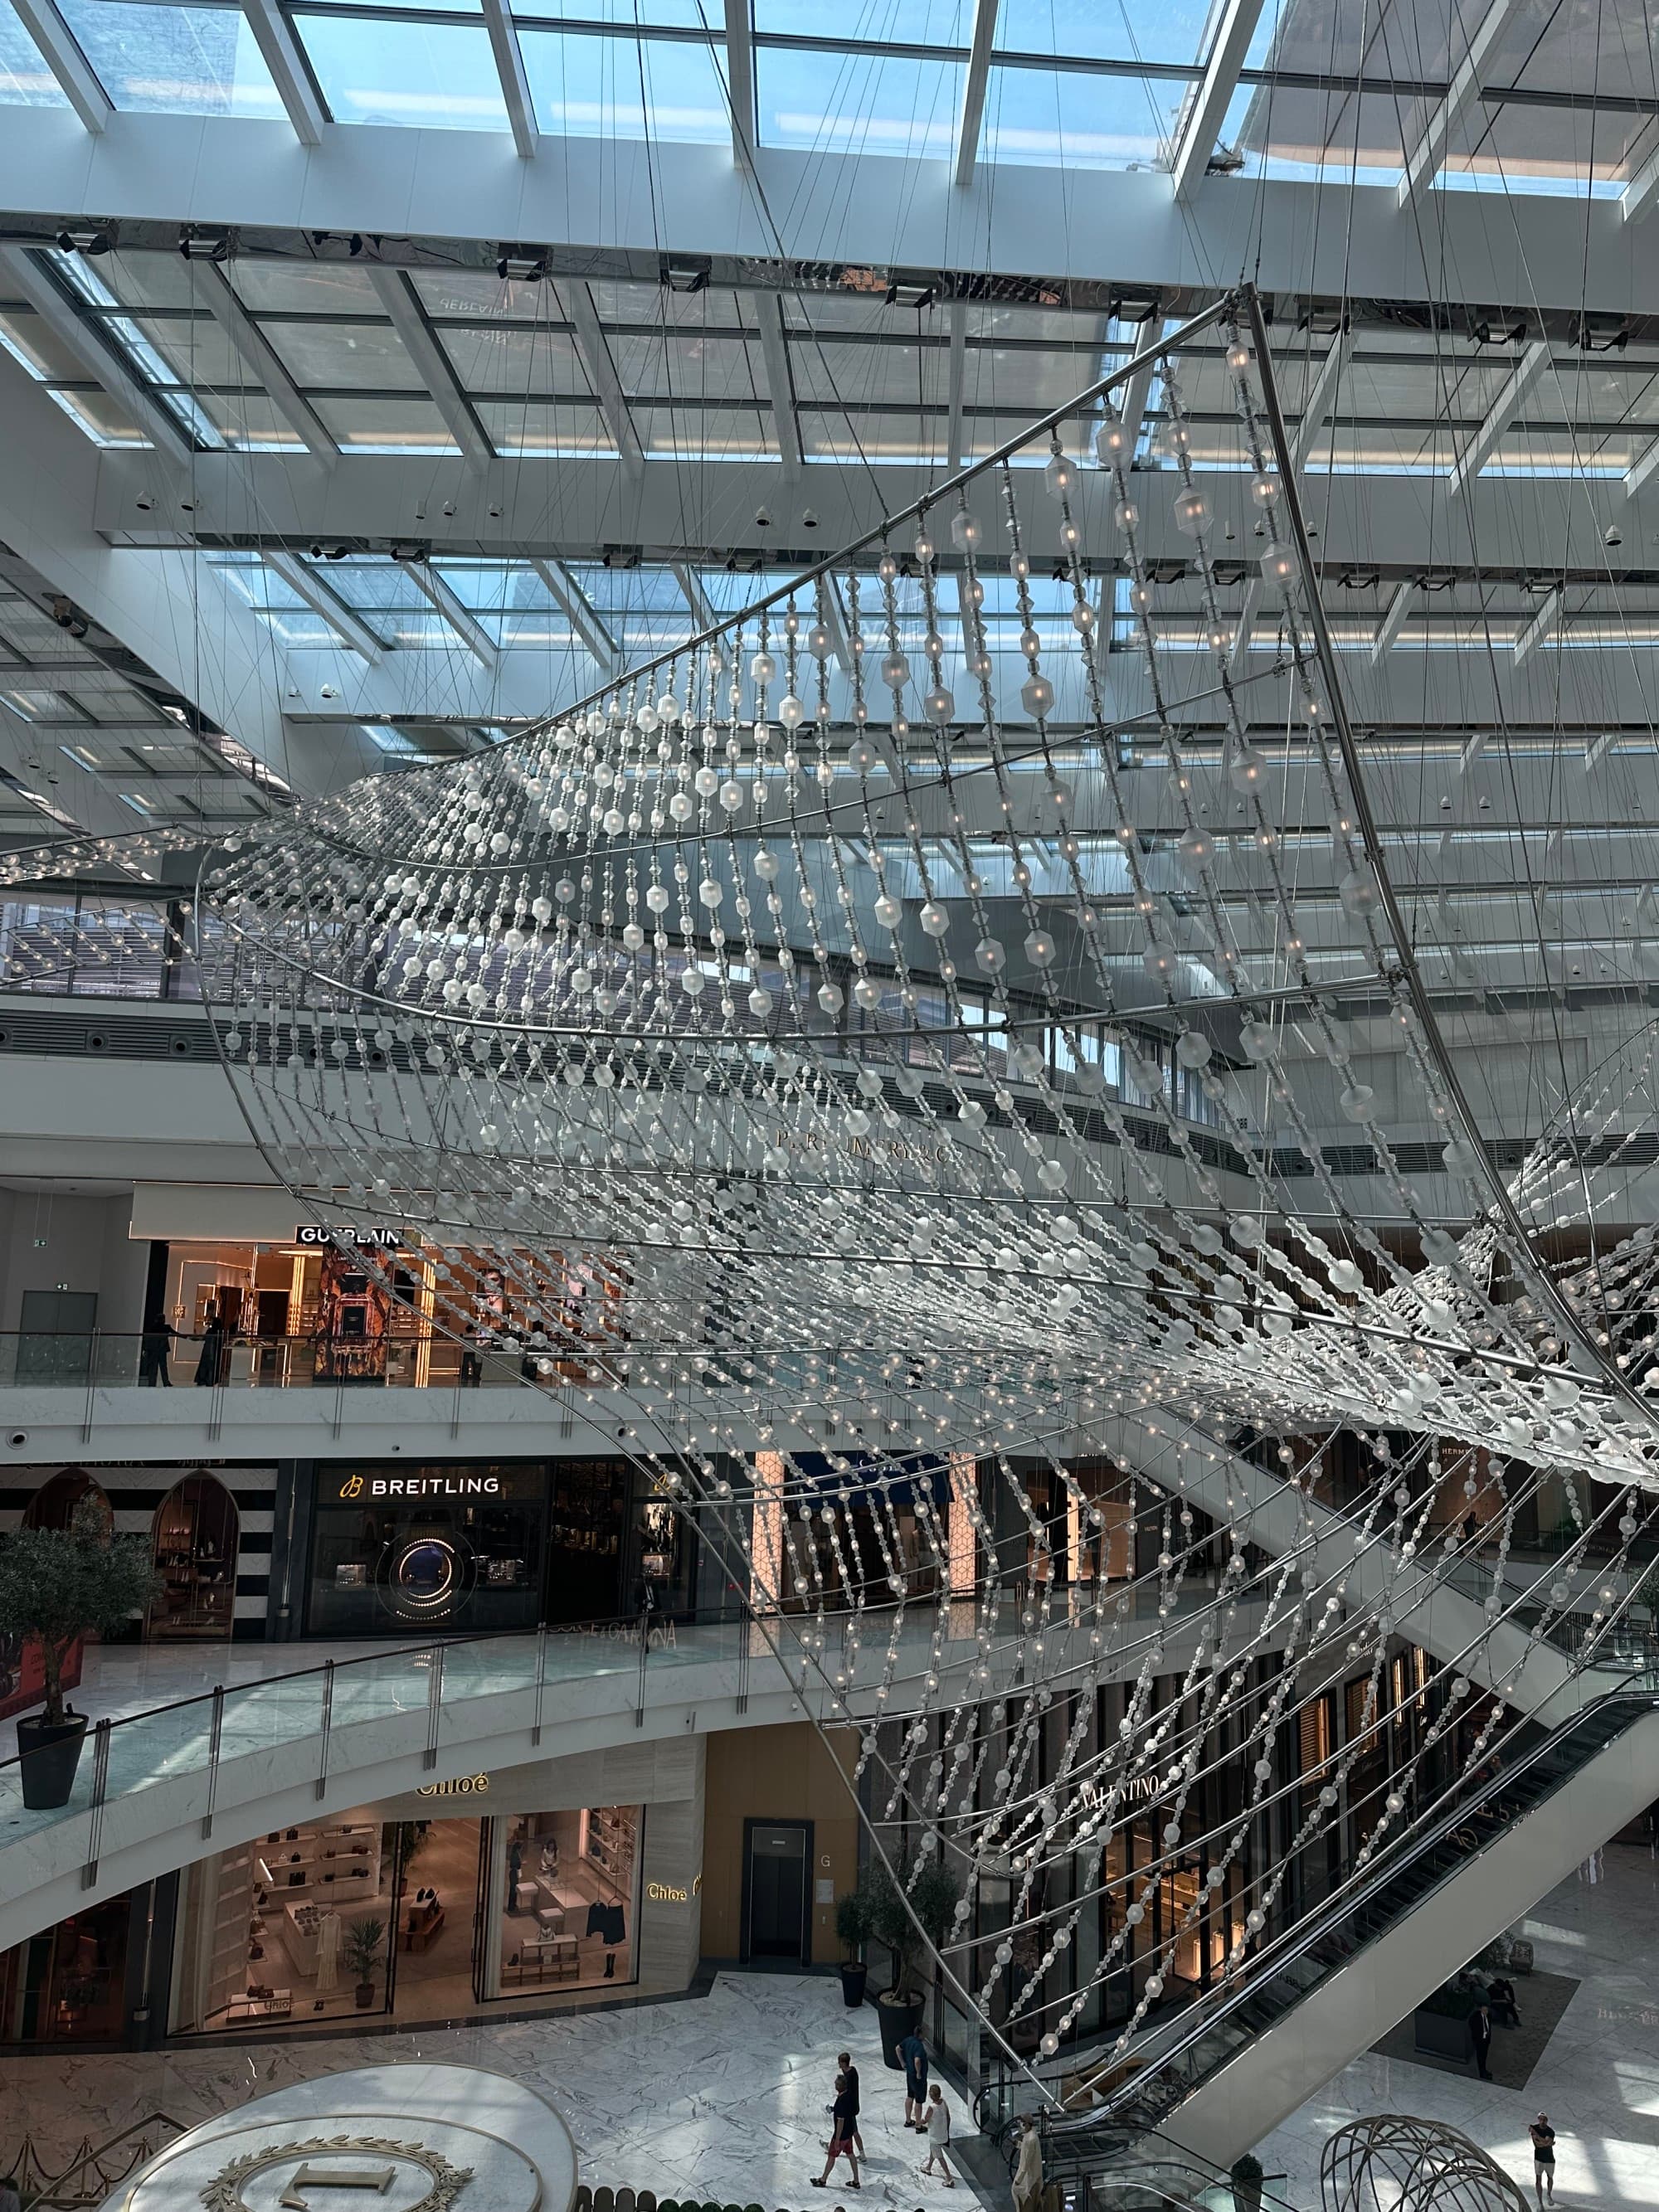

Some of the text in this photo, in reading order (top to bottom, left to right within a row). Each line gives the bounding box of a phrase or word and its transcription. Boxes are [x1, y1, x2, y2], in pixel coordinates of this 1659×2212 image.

[776, 1127, 912, 1159] PRMRY
[301, 1228, 399, 1244] GURLAIN
[1442, 1447, 1472, 1456] HERM
[372, 1478, 499, 1495] BREITLING
[820, 1855, 830, 1868] G
[647, 1883, 688, 1902] Chloé
